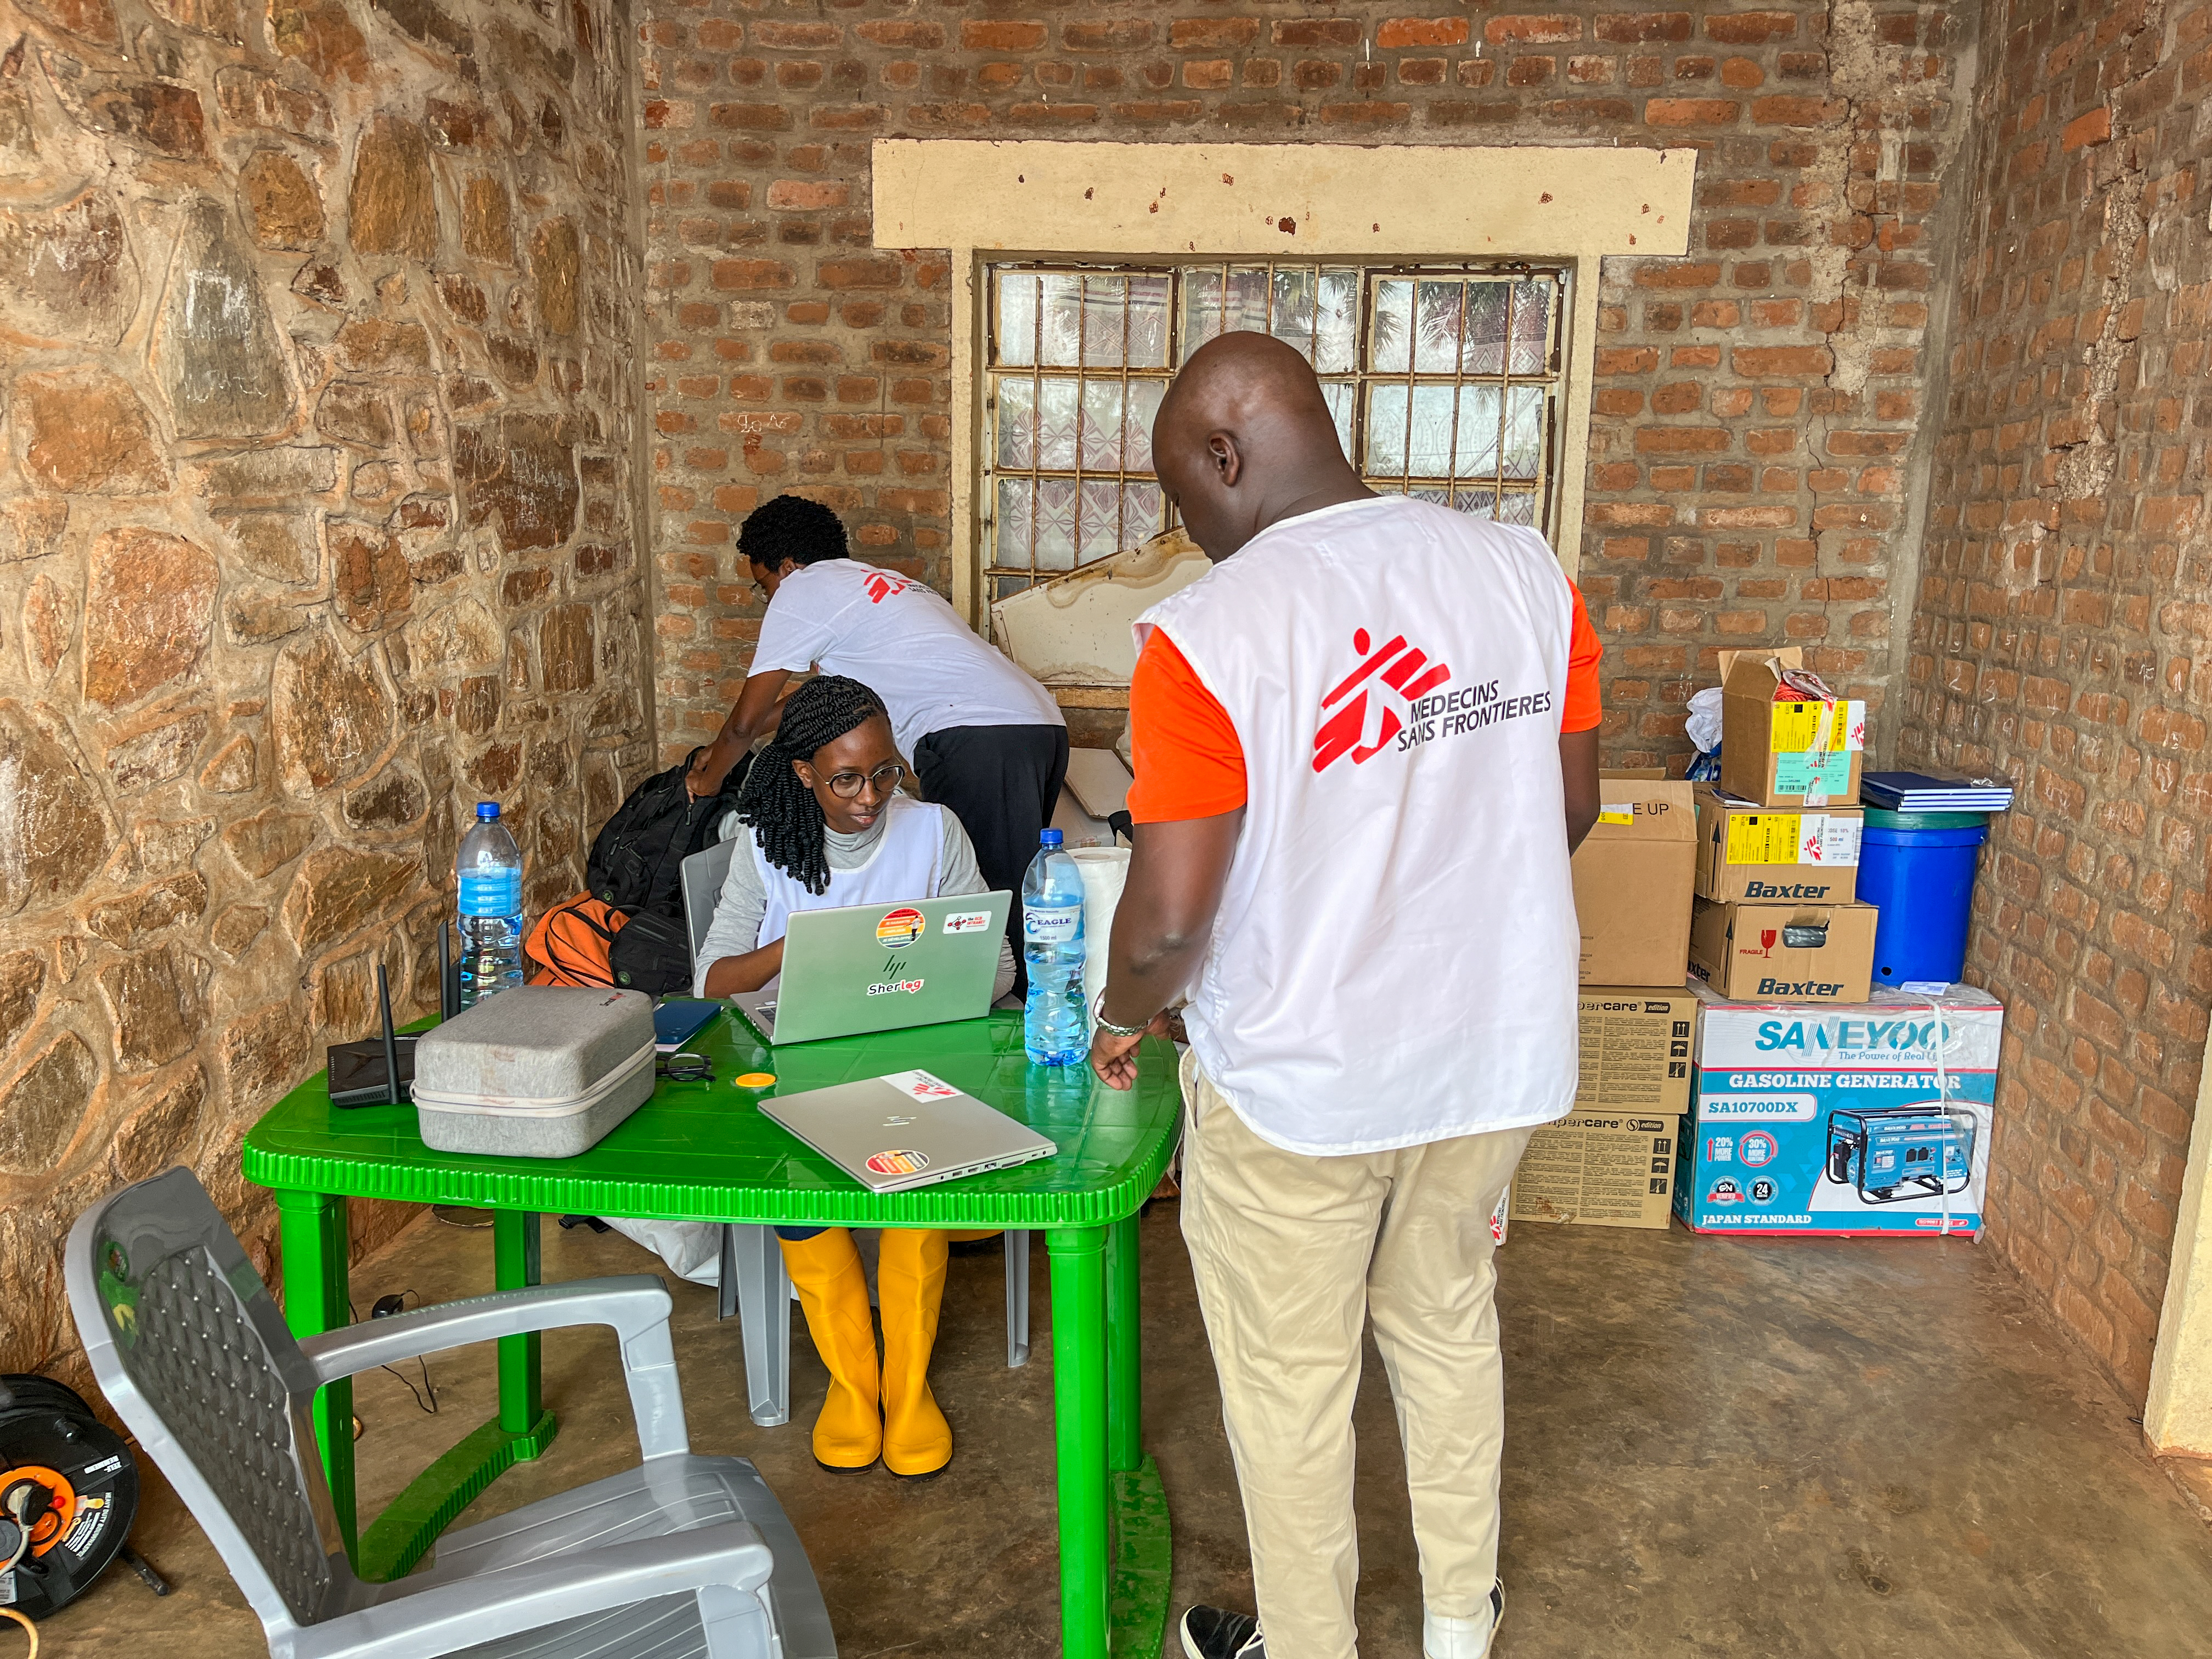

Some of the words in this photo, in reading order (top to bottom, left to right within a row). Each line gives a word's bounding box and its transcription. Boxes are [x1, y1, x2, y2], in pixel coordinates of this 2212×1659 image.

[1949, 665, 1961, 691] 2
[1982, 679, 1995, 704] 3
[1410, 680, 1498, 724] MEDECINS
[1397, 719, 1435, 752] SANS
[1442, 690, 1551, 738] FRONTIERES
[1633, 803, 1643, 815] E
[1647, 803, 1669, 815] UP
[1744, 882, 1831, 898] Baxter
[869, 980, 921, 995] Sherlog
[1757, 978, 1844, 996] Baxter
[1755, 1017, 1949, 1056] SANEYOO
[1839, 1051, 1856, 1060] The
[1858, 1051, 1889, 1060] Power
[1892, 1051, 1903, 1062] of
[1904, 1052, 1925, 1060] Real
[1729, 1074, 1832, 1088] GASOLINE
[1708, 1102, 1798, 1113] SA10700DX
[1716, 1137, 1733, 1147] 20%
[1748, 1138, 1767, 1149] 30%
[1757, 1184, 1768, 1194] 24
[1702, 1215, 1742, 1226] JAPAN
[1743, 1215, 1812, 1224] STANDARD
[100, 1509, 110, 1523] DUTY
